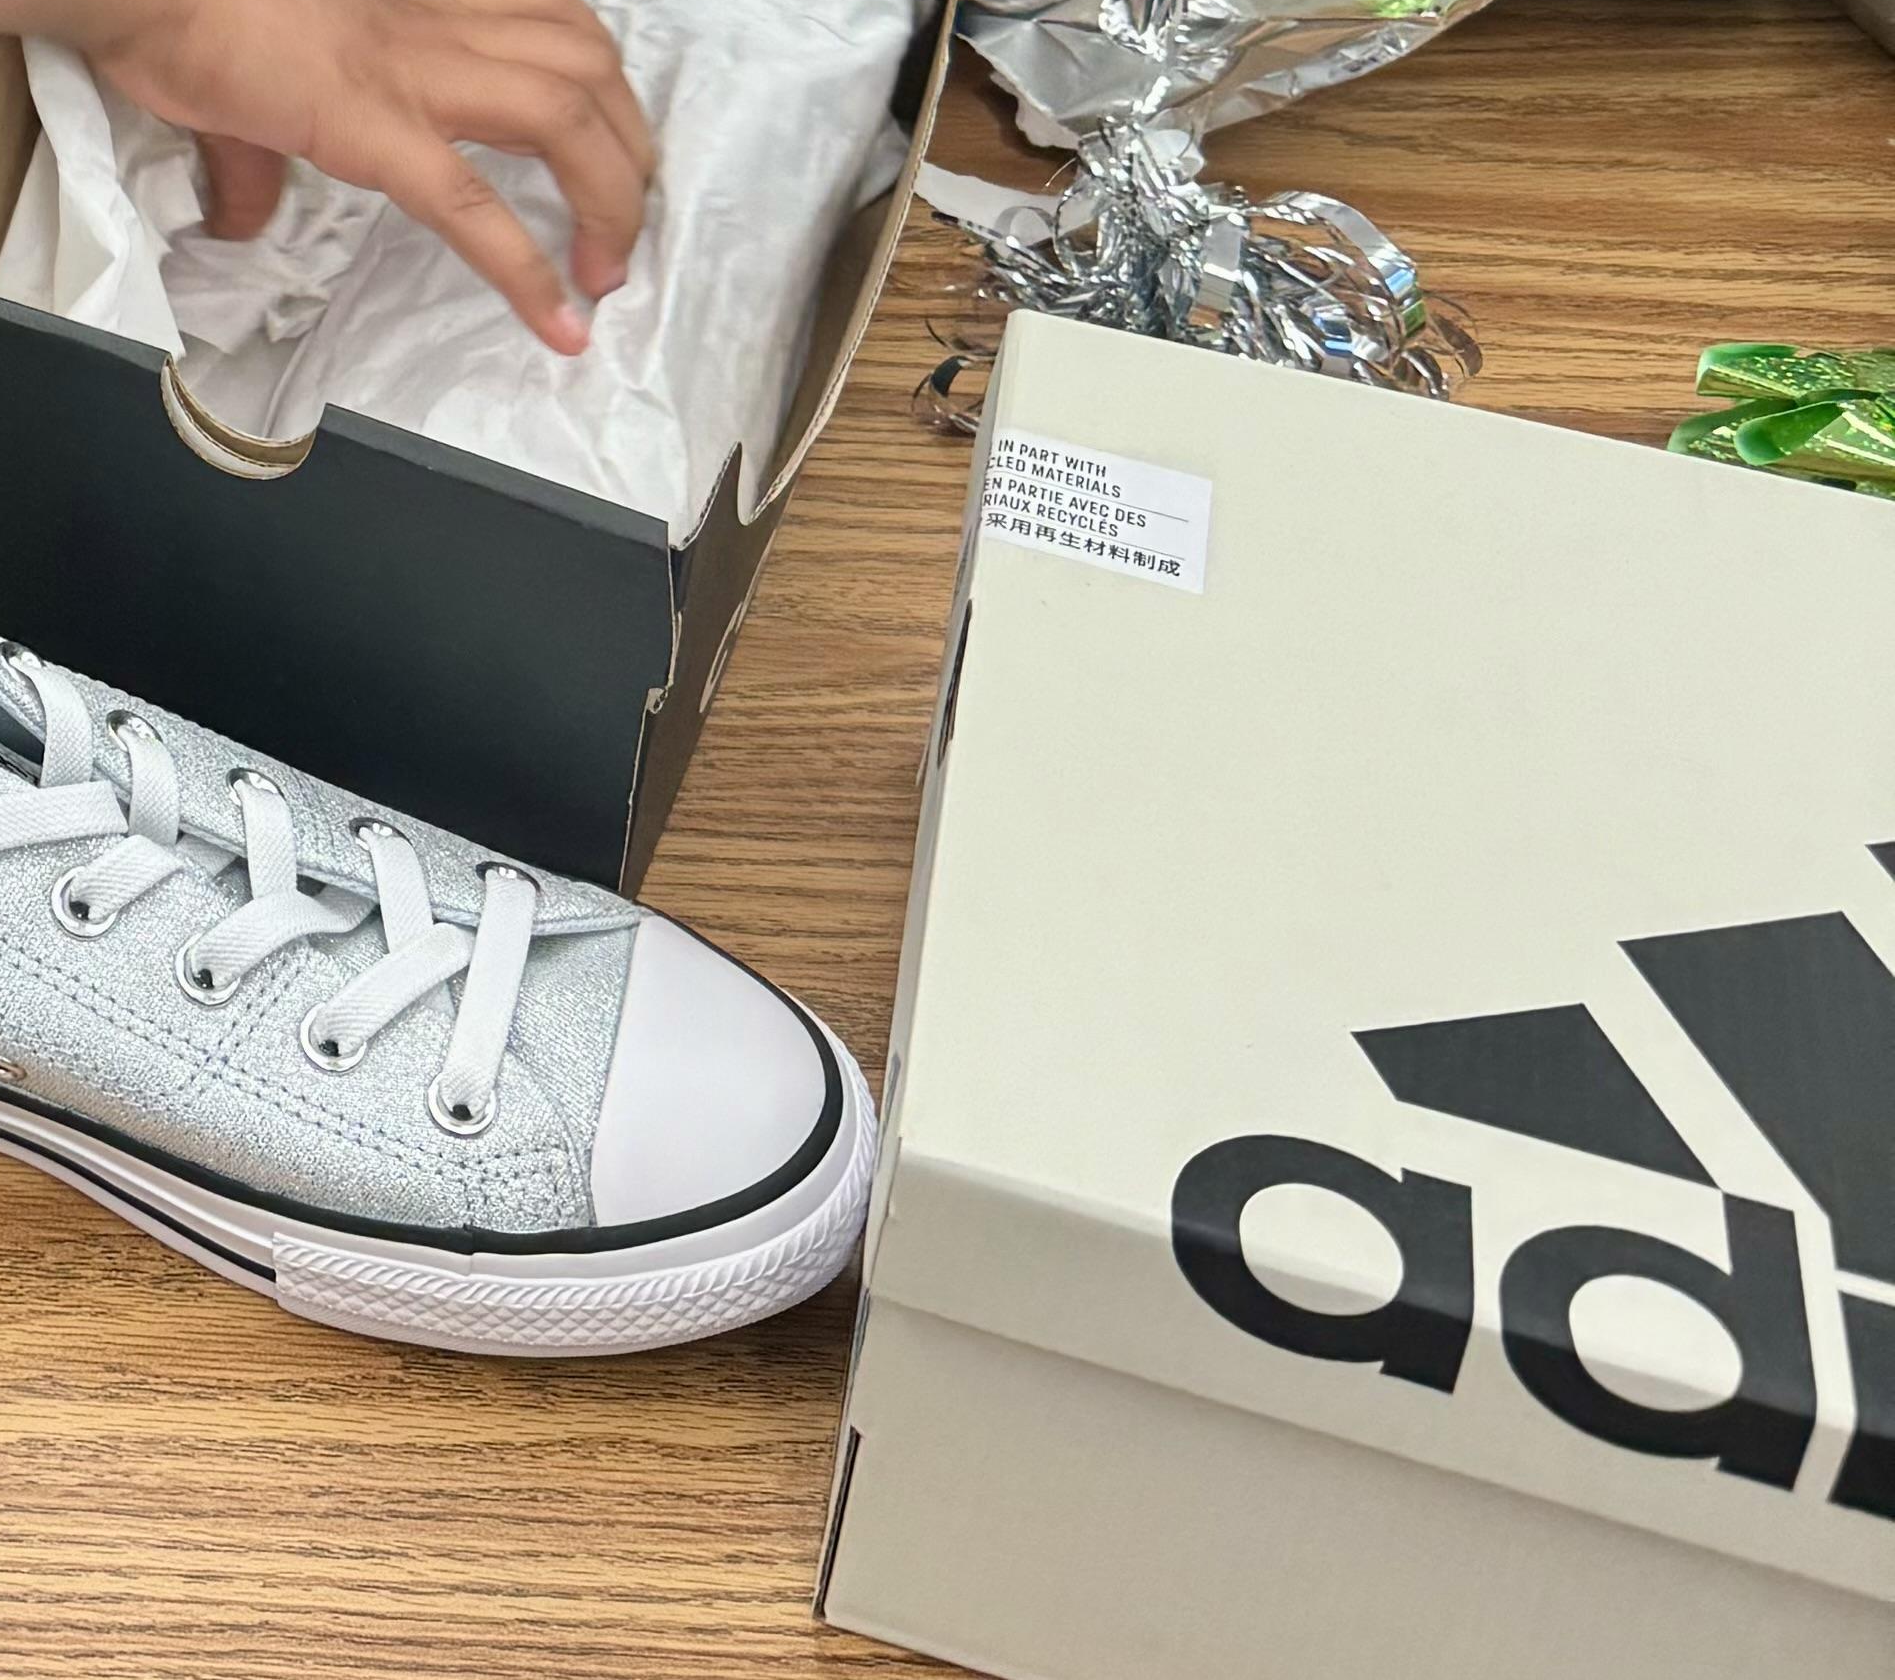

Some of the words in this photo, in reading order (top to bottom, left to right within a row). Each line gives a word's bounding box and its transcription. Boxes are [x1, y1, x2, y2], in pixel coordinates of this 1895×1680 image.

[998, 439, 1014, 453] IN
[1019, 443, 1060, 464] PART
[1065, 456, 1107, 477] WITH
[984, 477, 1003, 491] EN
[1008, 479, 1064, 505] PARTIE
[1069, 496, 1110, 517] AVEC
[1115, 508, 1146, 528] DES
[1031, 463, 1122, 499] MATERIALS
[983, 494, 1031, 514] RIAUX
[1036, 504, 1119, 538] RECYCLÉS
[985, 512, 1181, 578] 采用再生材料制成
